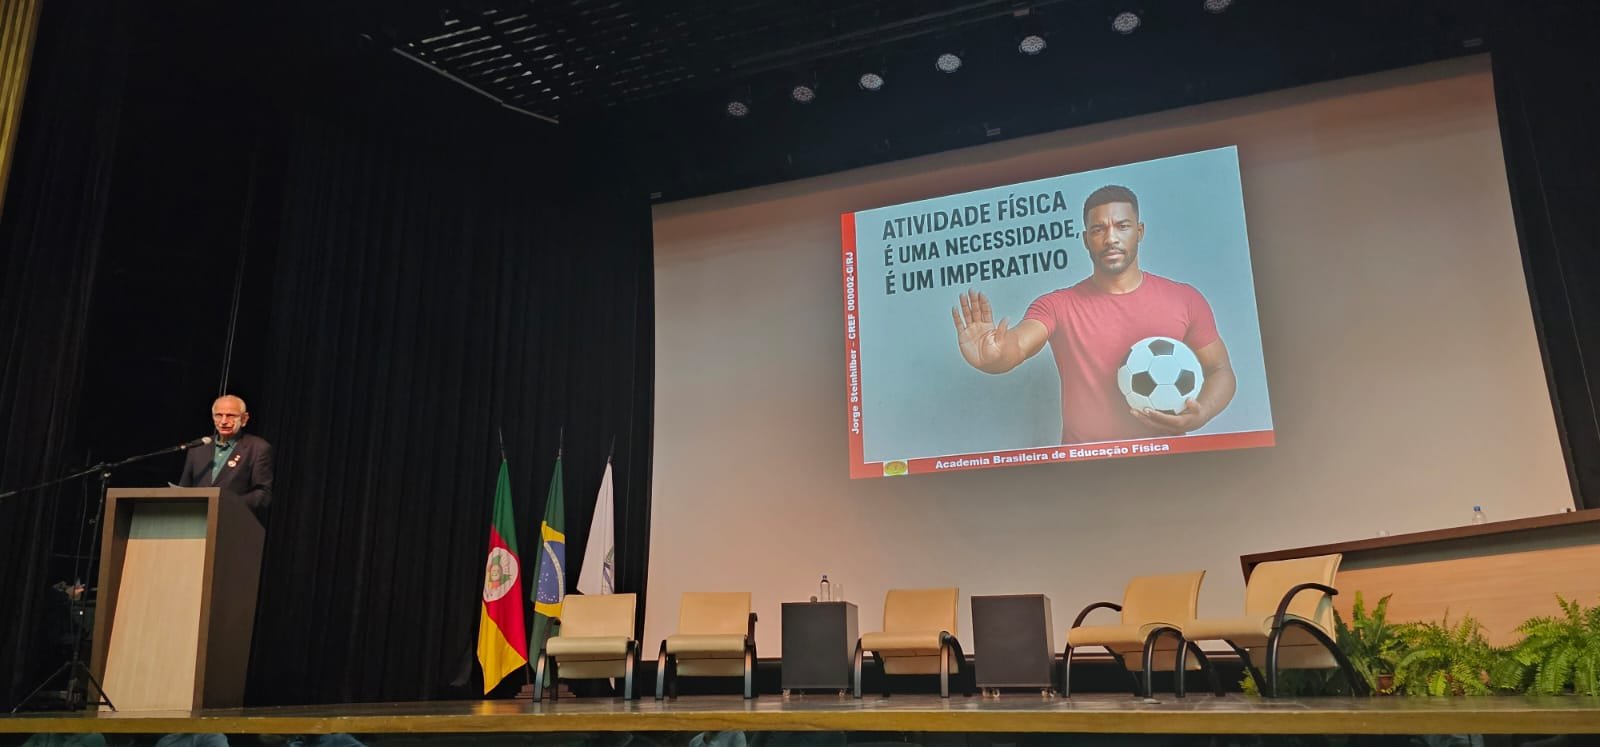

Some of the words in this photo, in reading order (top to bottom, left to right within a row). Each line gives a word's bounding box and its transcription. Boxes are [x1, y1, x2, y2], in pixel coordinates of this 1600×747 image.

[882, 203, 990, 241] ATIVIDADE
[998, 190, 1067, 221] FÍSICA
[884, 244, 894, 266] É
[899, 241, 940, 264] UMA
[945, 219, 1080, 257] NECESSIDADE,
[885, 270, 896, 294] É
[902, 268, 934, 292] UM
[940, 248, 1068, 286] IMPERATIVO
[847, 313, 856, 340] CREF
[849, 349, 858, 402] Steinhilber
[851, 405, 861, 434] Jorge
[935, 458, 990, 469] Academia
[993, 453, 1048, 464] Brasileira
[1051, 450, 1066, 459] de
[1069, 446, 1128, 458] Educação
